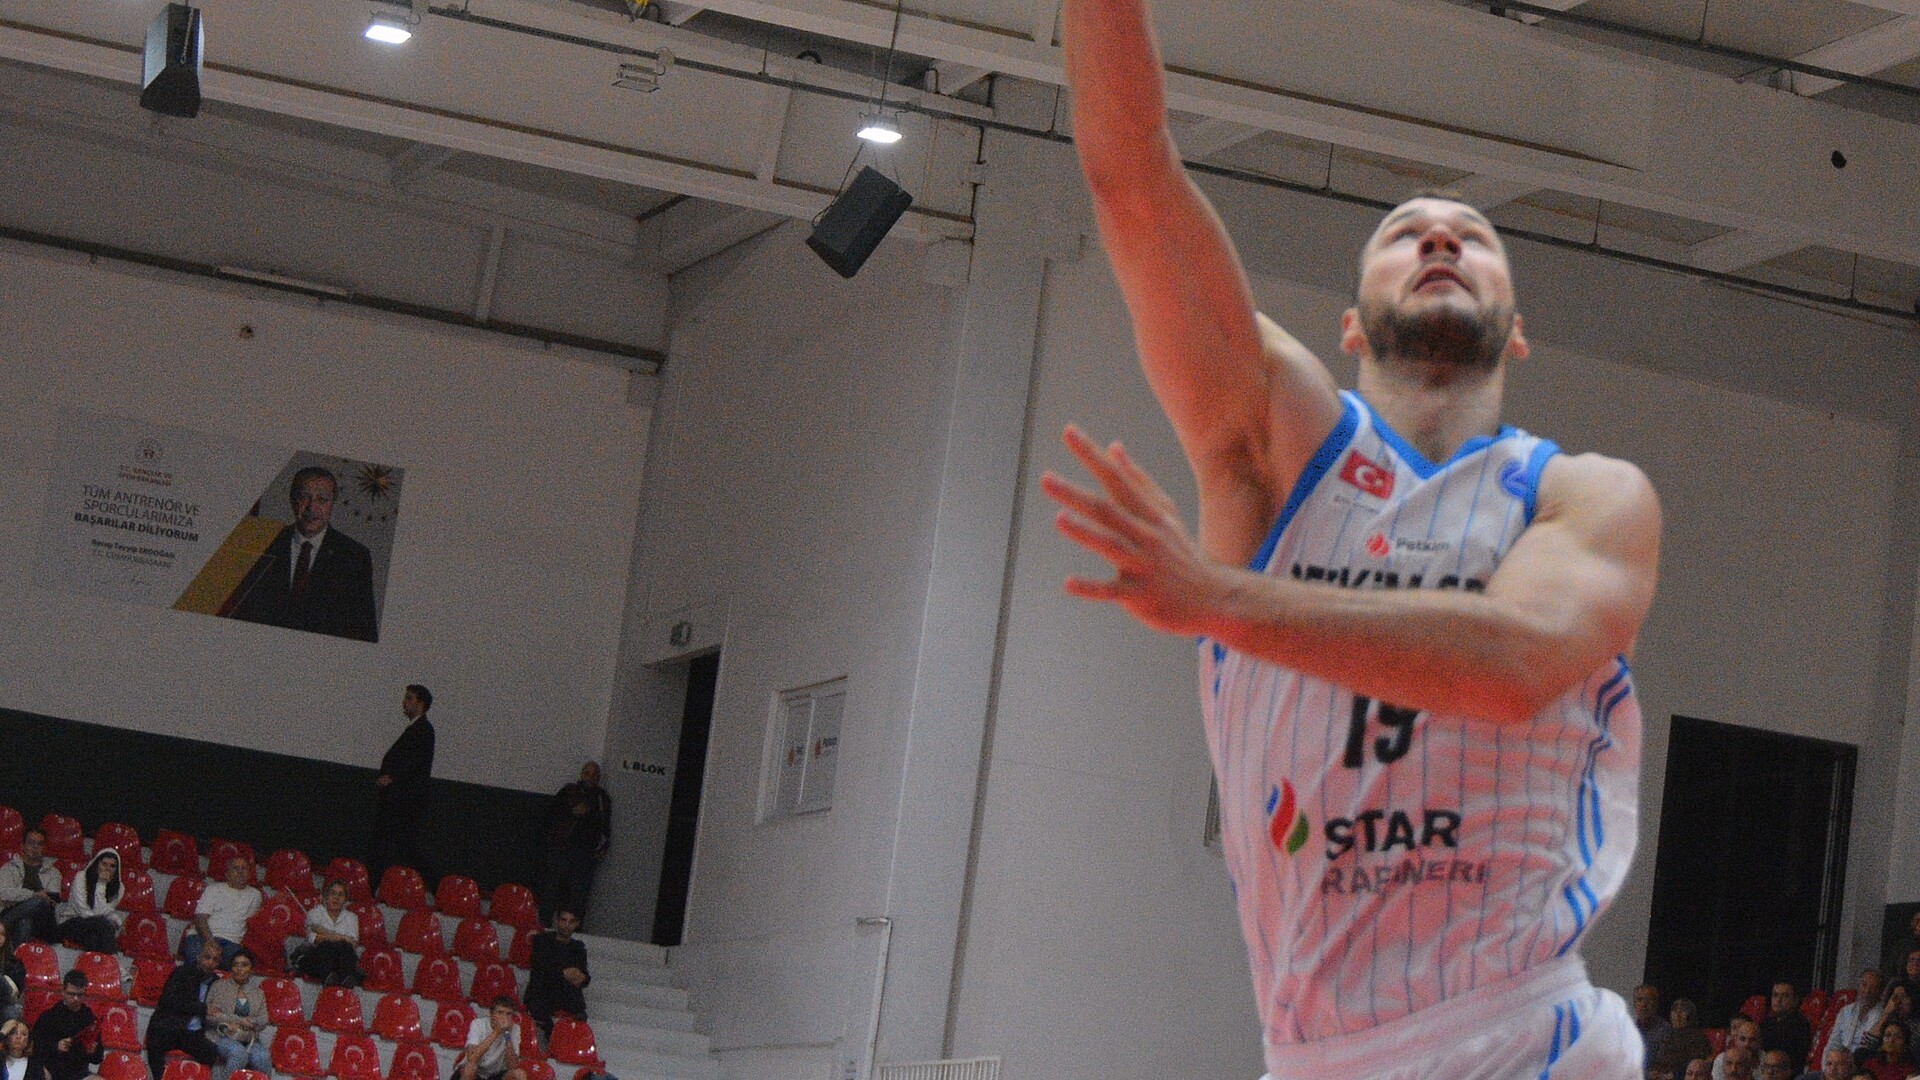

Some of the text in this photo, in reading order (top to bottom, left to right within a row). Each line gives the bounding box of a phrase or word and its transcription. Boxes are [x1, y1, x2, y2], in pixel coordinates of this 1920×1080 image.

[185, 503, 199, 516] VE
[74, 512, 199, 541] BAŞARILAR DİLİYORUM
[1343, 693, 1421, 768] 19
[633, 761, 665, 776] BLOK
[1325, 808, 1461, 860] STAR
[30, 945, 43, 954] 10
